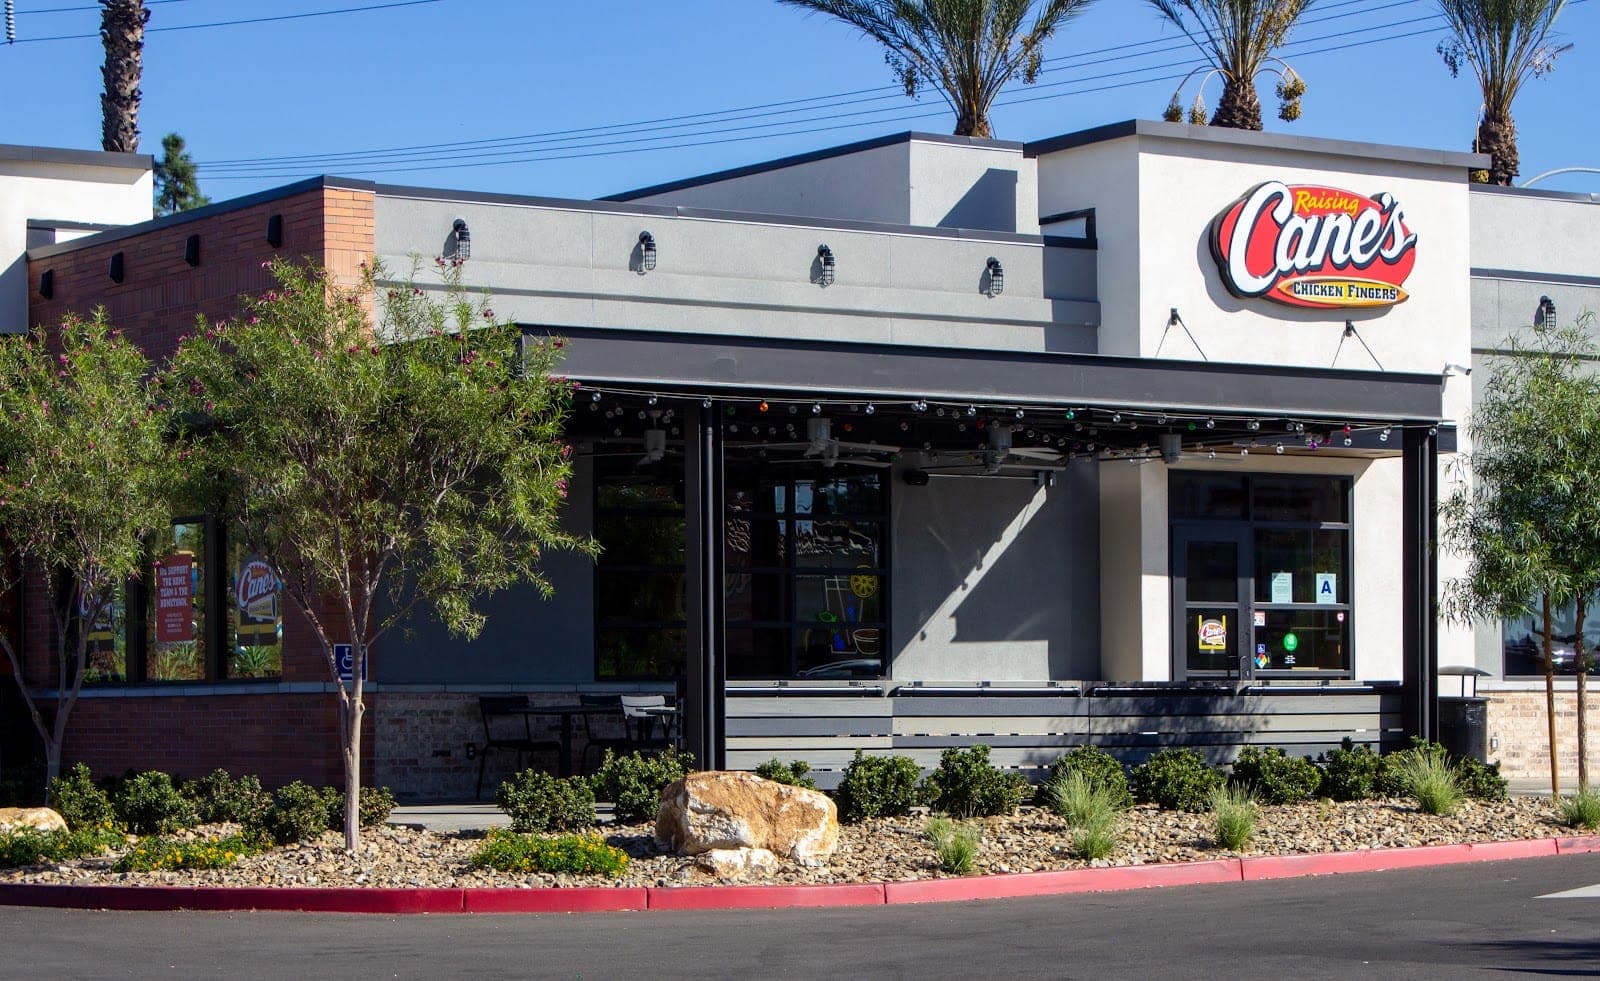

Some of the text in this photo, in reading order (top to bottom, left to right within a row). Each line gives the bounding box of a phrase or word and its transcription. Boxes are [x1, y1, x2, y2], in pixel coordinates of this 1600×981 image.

[1294, 190, 1359, 216] Raising
[1229, 181, 1417, 294] Cane's
[1293, 281, 1397, 300] CHICKEN FINGERS
[1321, 580, 1332, 594] A
